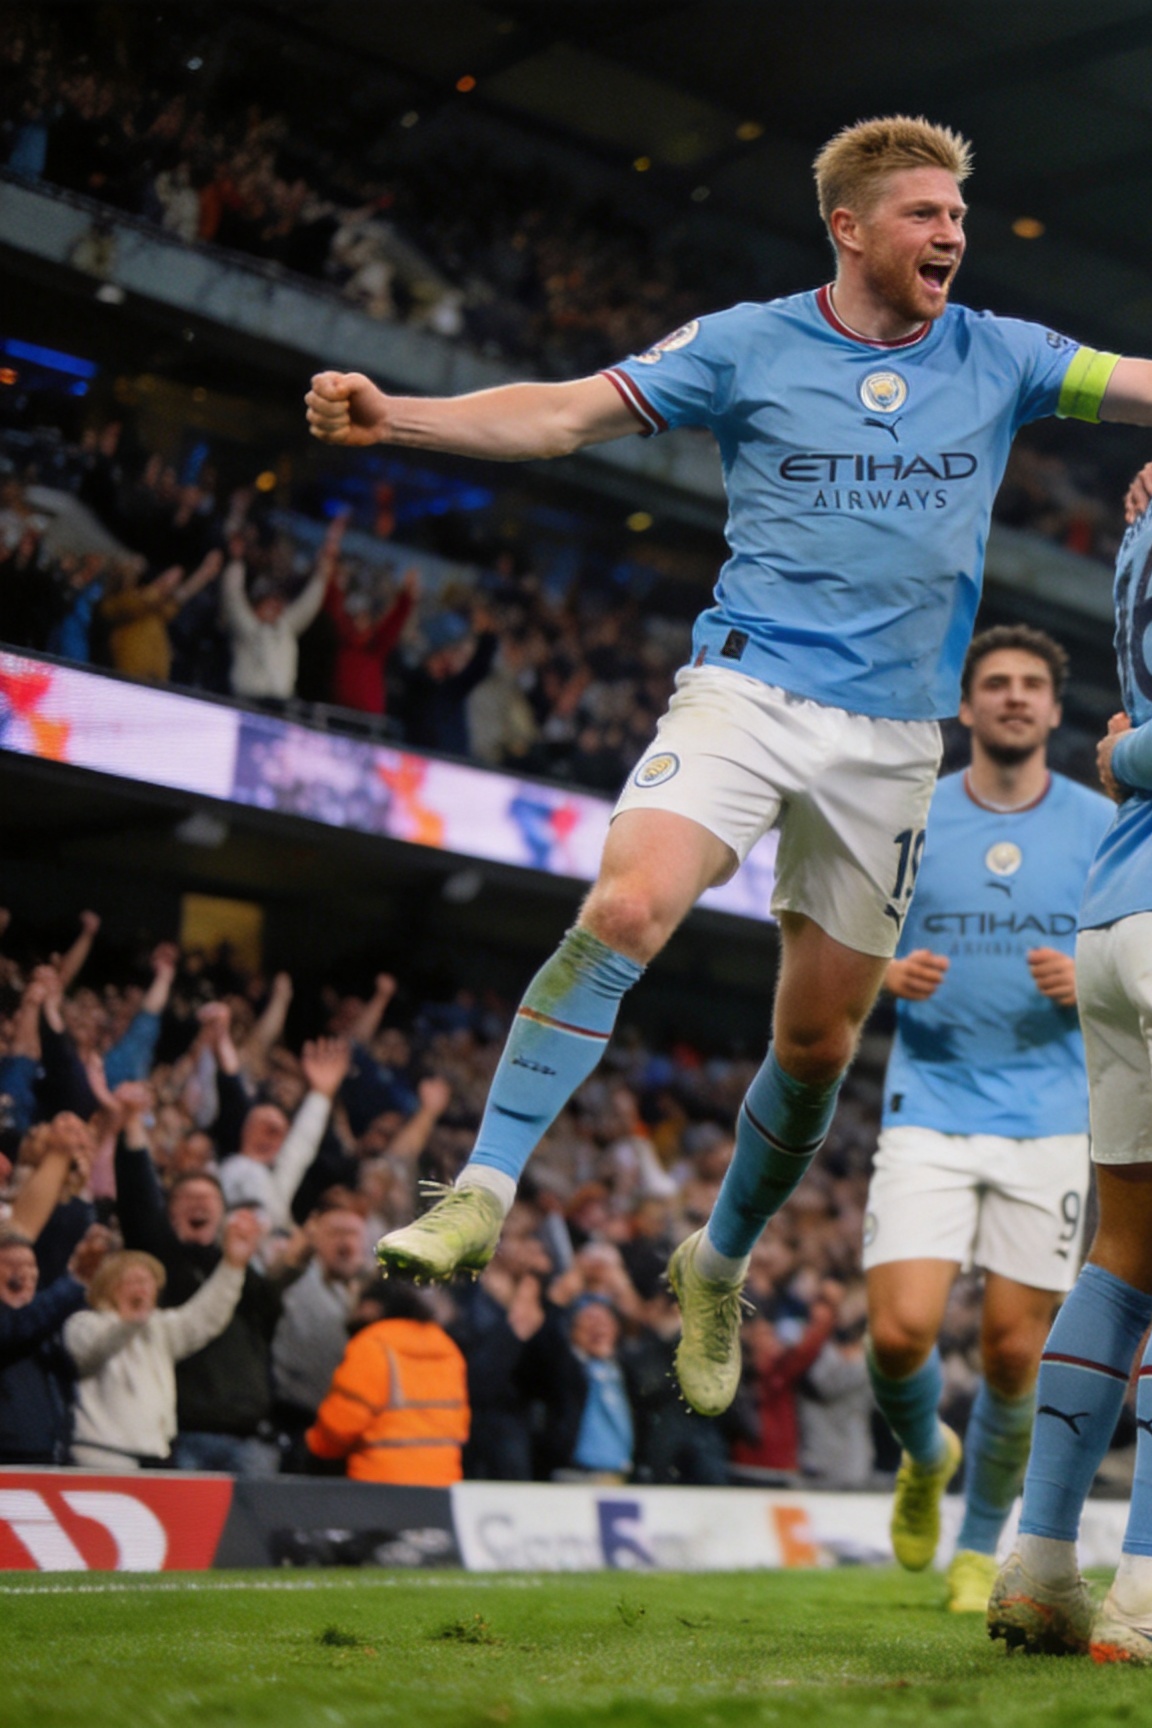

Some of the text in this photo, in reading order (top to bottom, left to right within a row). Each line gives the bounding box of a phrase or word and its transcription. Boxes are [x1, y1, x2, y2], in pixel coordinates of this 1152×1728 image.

[779, 452, 978, 483] ETIHAD
[813, 488, 948, 510] AIRWAYS
[923, 911, 1078, 937] ETIHAD
[1059, 1190, 1081, 1242] 9
